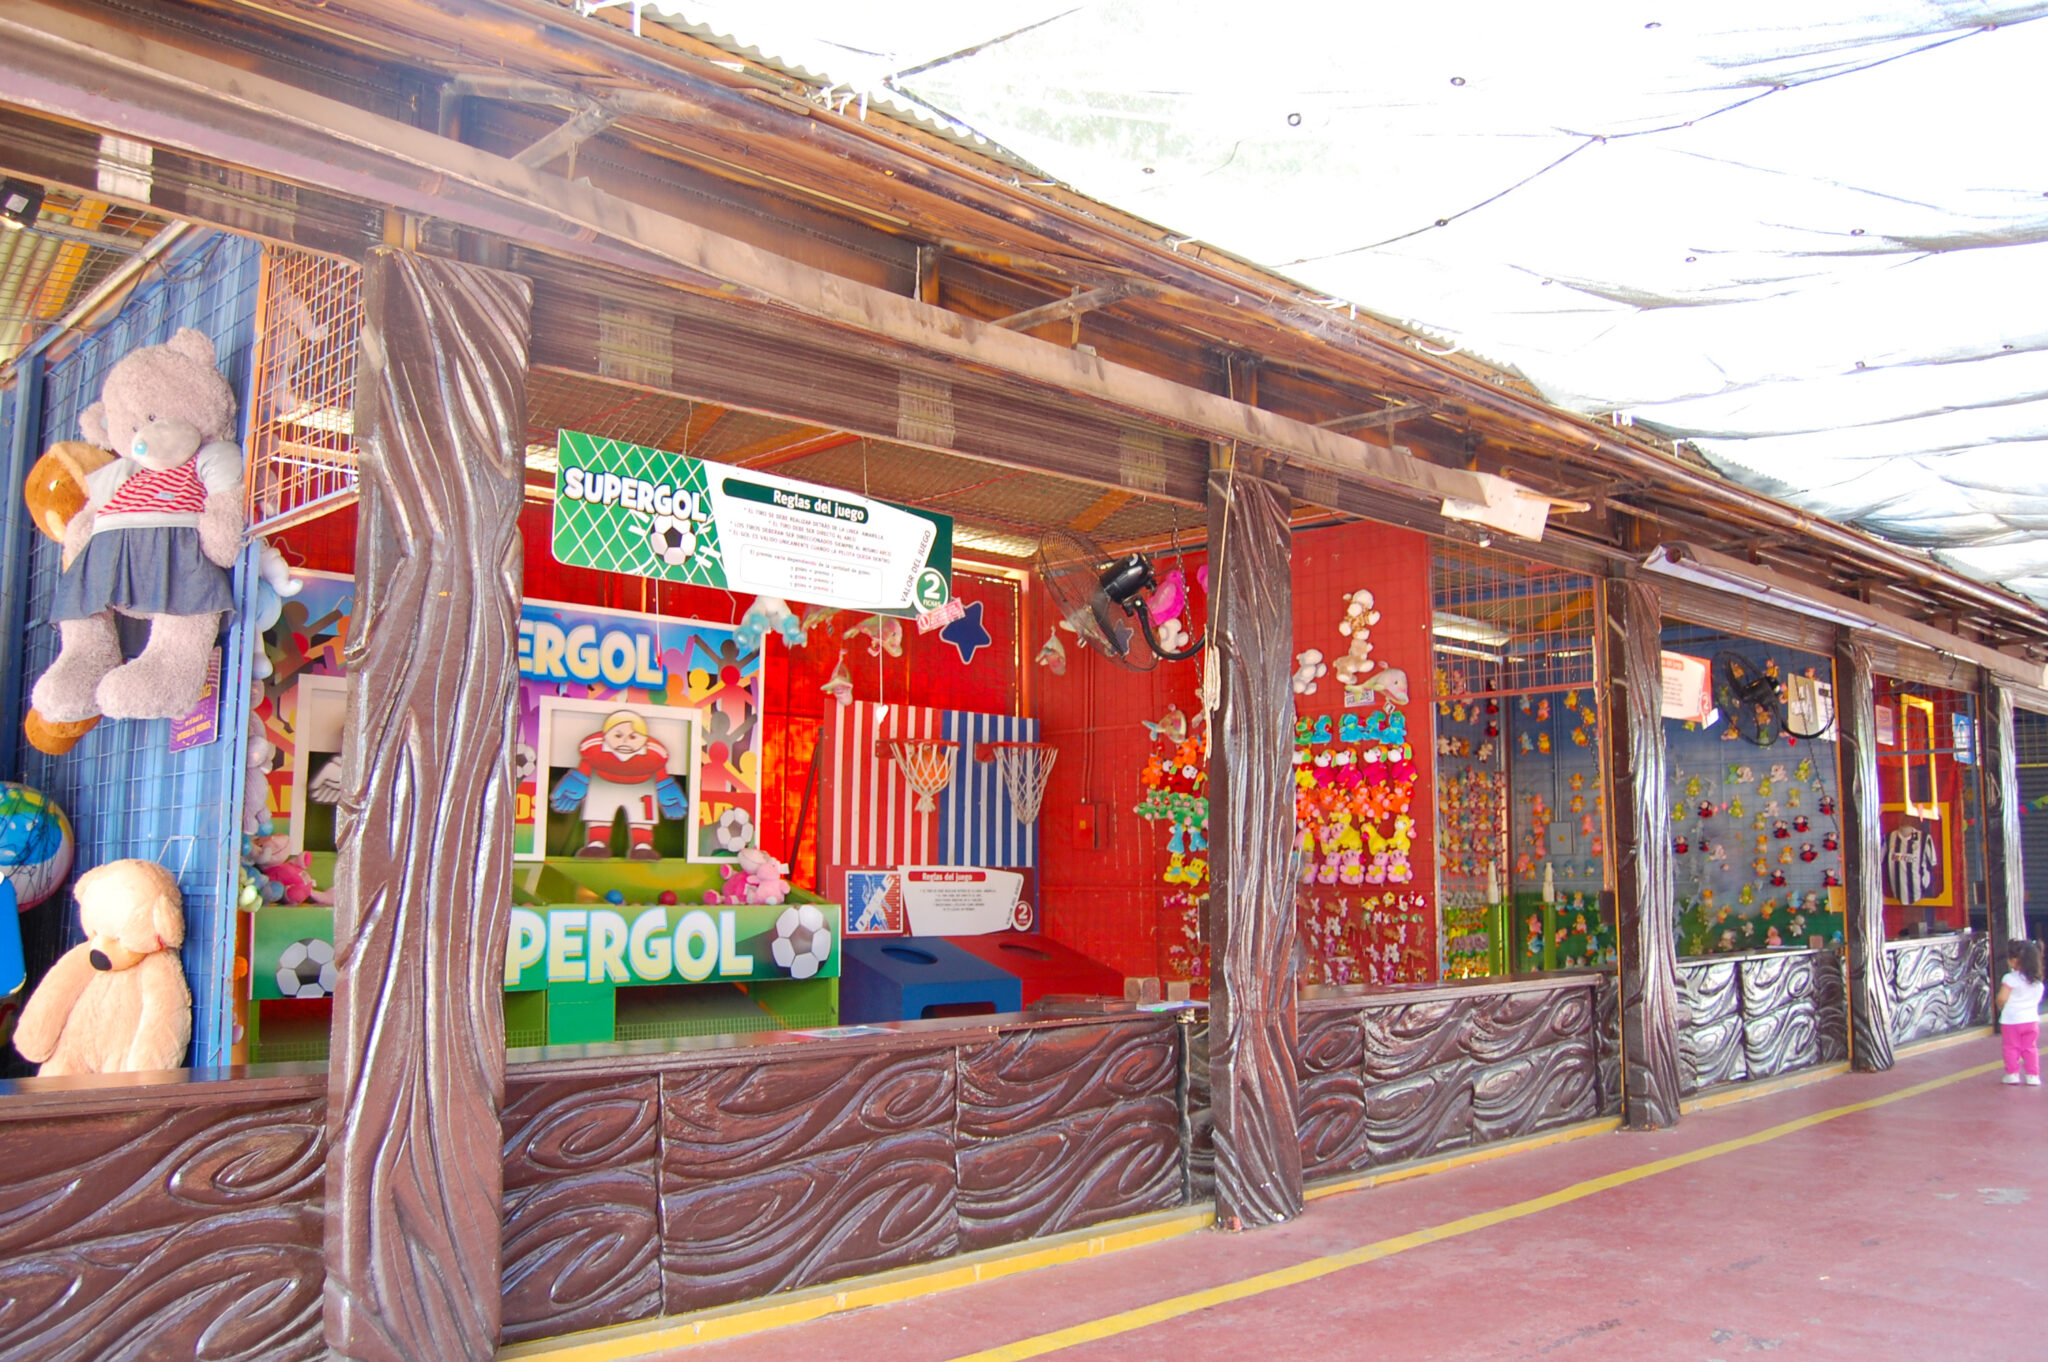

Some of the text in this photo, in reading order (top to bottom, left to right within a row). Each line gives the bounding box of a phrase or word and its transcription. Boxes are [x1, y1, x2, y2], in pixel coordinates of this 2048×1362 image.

[563, 466, 708, 523] SUPERGOL
[773, 489, 865, 522] Reglas del juego
[901, 530, 931, 602] VALOR DEL JUEGO
[924, 573, 941, 600] 2
[640, 794, 654, 820] 1
[922, 872, 943, 882] Reglas
[944, 871, 955, 881] del
[1018, 903, 1028, 920] 2
[504, 906, 753, 986] PERGOL
